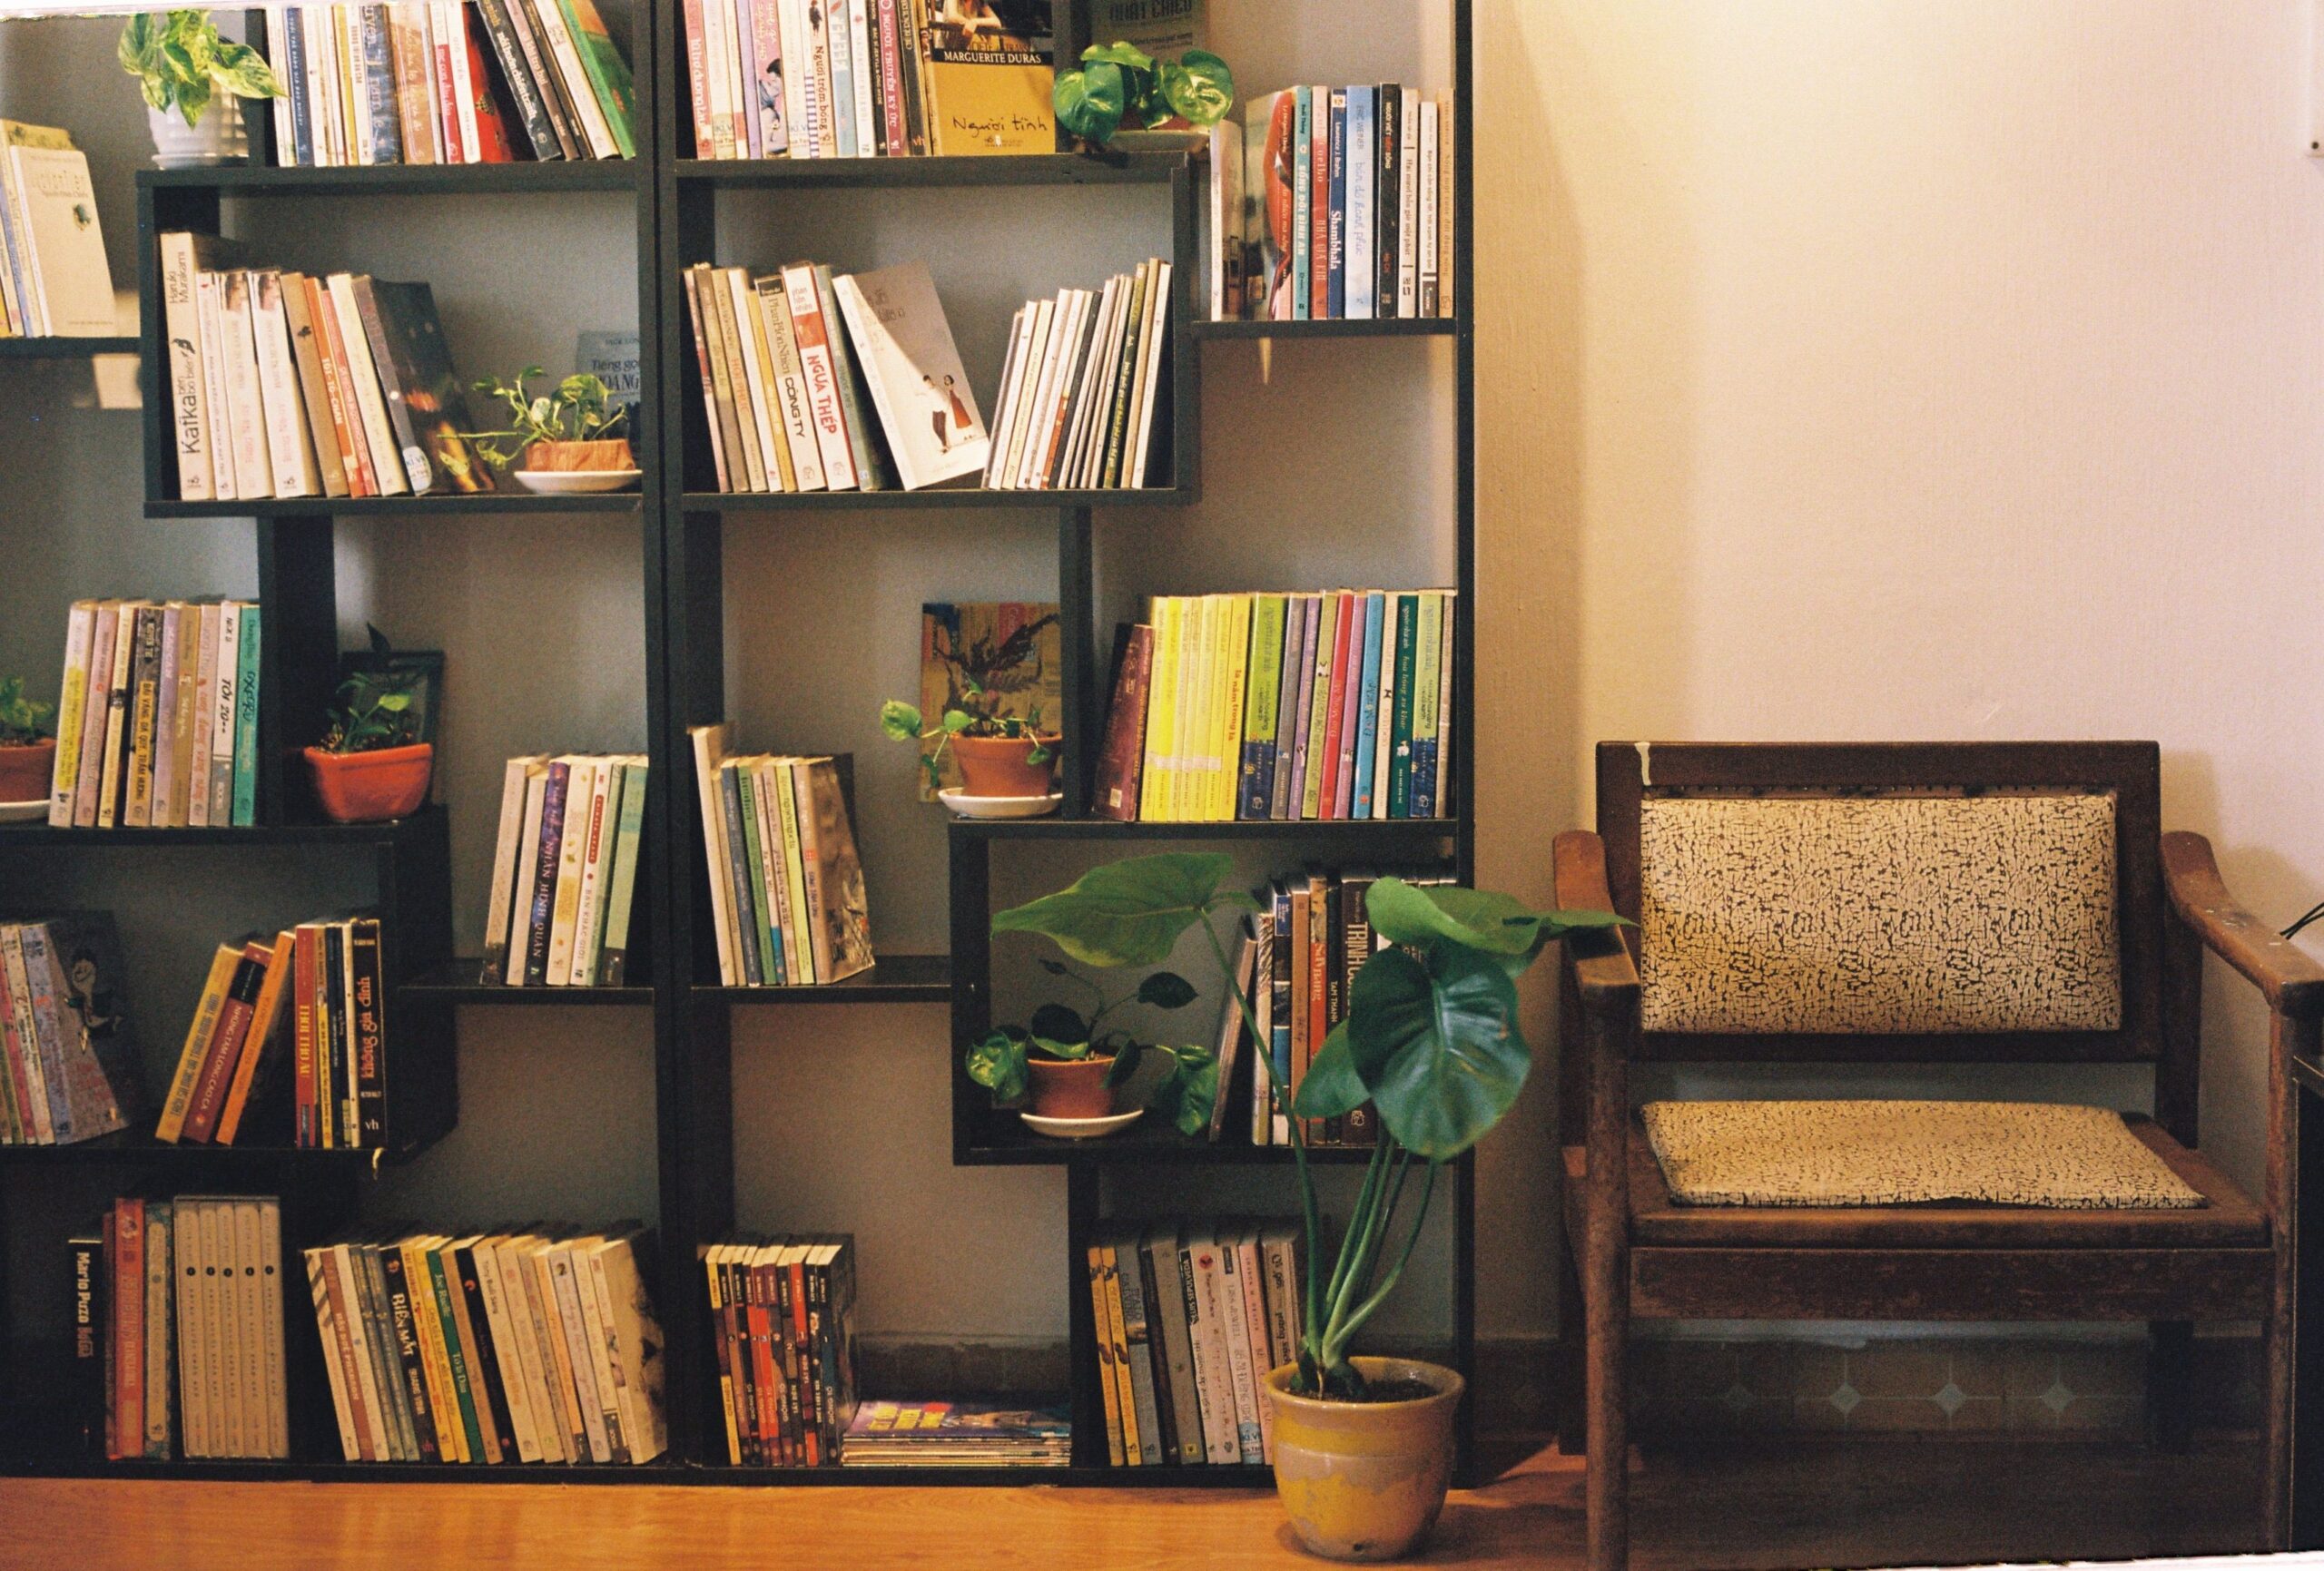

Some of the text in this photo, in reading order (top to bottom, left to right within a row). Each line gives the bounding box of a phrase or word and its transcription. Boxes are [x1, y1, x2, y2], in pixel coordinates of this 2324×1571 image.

[944, 51, 1041, 64] MARGUERITE DURAS
[953, 114, 1047, 138] Người tình
[1330, 211, 1342, 270] Shambhala
[168, 252, 190, 302] Haruki Murakami
[784, 378, 804, 437] CÔNG TY
[807, 355, 838, 434] NGỰA THÉP
[177, 395, 201, 454] Kafka
[1229, 704, 1239, 731] trong
[1344, 922, 1369, 964] TRỊNH
[358, 977, 372, 1006] đình
[359, 1012, 378, 1032] gia
[360, 1036, 378, 1078] không
[205, 1079, 218, 1096] CAO
[481, 1261, 491, 1276] Tony
[77, 1252, 91, 1323] Mario Puzo
[1188, 1301, 1196, 1313] LUIS
